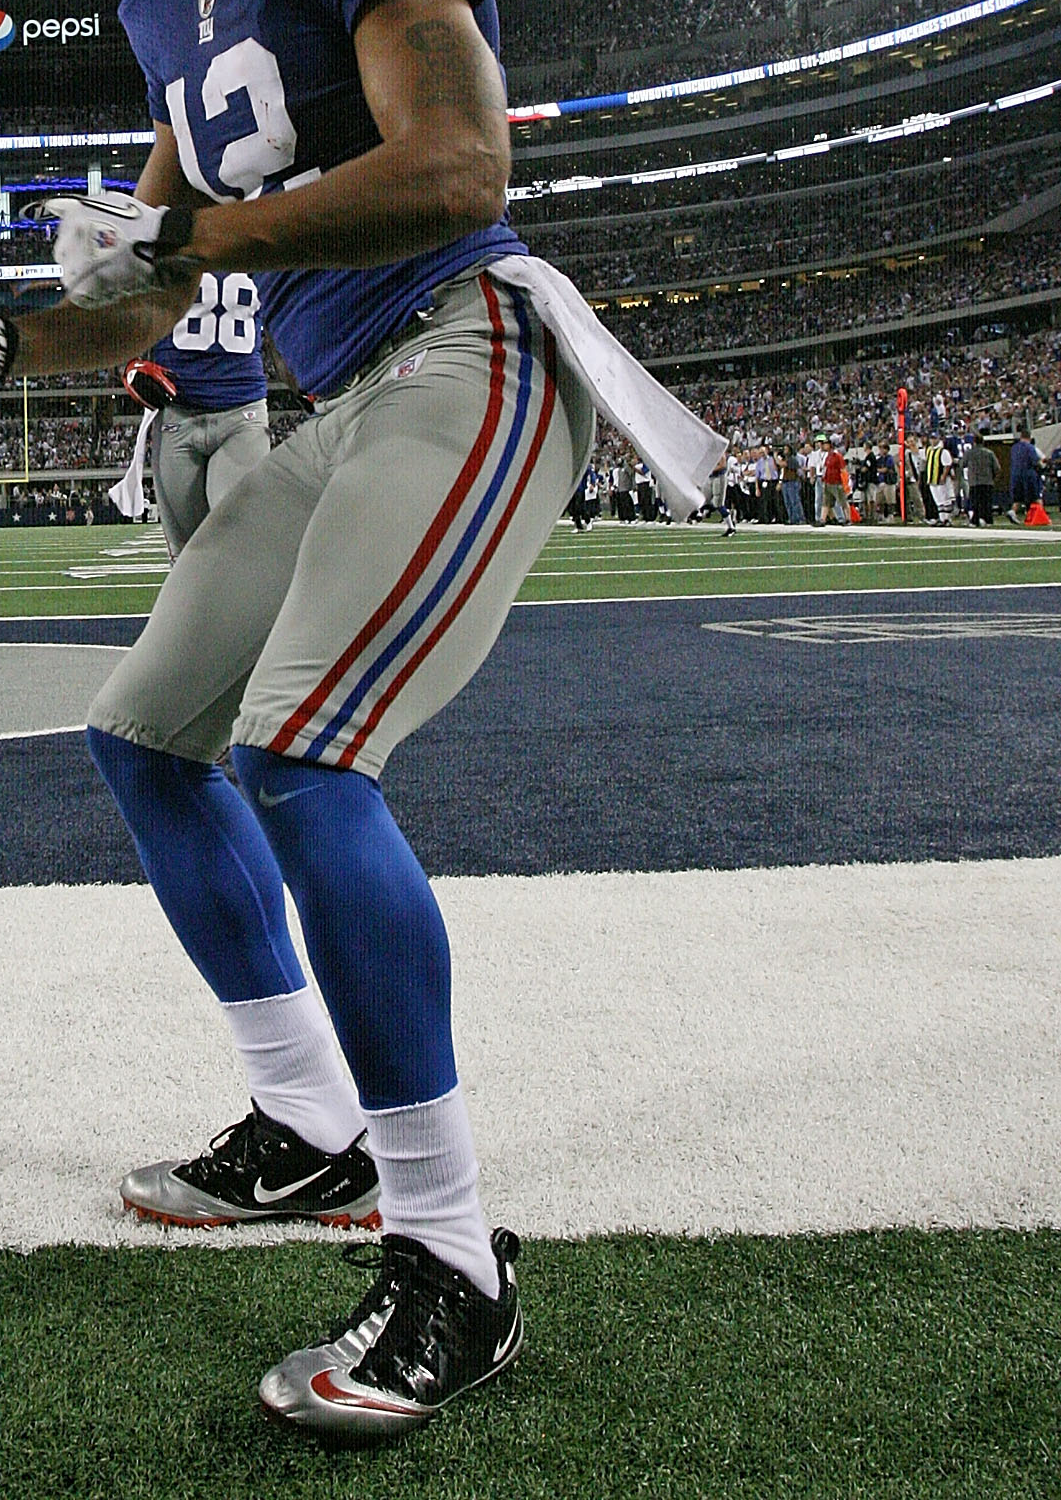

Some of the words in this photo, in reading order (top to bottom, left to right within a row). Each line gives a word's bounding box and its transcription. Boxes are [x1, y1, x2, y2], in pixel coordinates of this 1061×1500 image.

[23, 13, 100, 46] pepsi
[627, 86, 673, 104] COWBOYS
[674, 73, 732, 97] TOUCHDOWN
[733, 66, 765, 84] TRAVEL
[842, 40, 868, 59] AWAY
[868, 31, 895, 51] GAME
[940, 3, 982, 30] STARTING
[13, 136, 41, 149] TRAVEL
[166, 37, 322, 204] 12
[173, 272, 261, 354] 88
